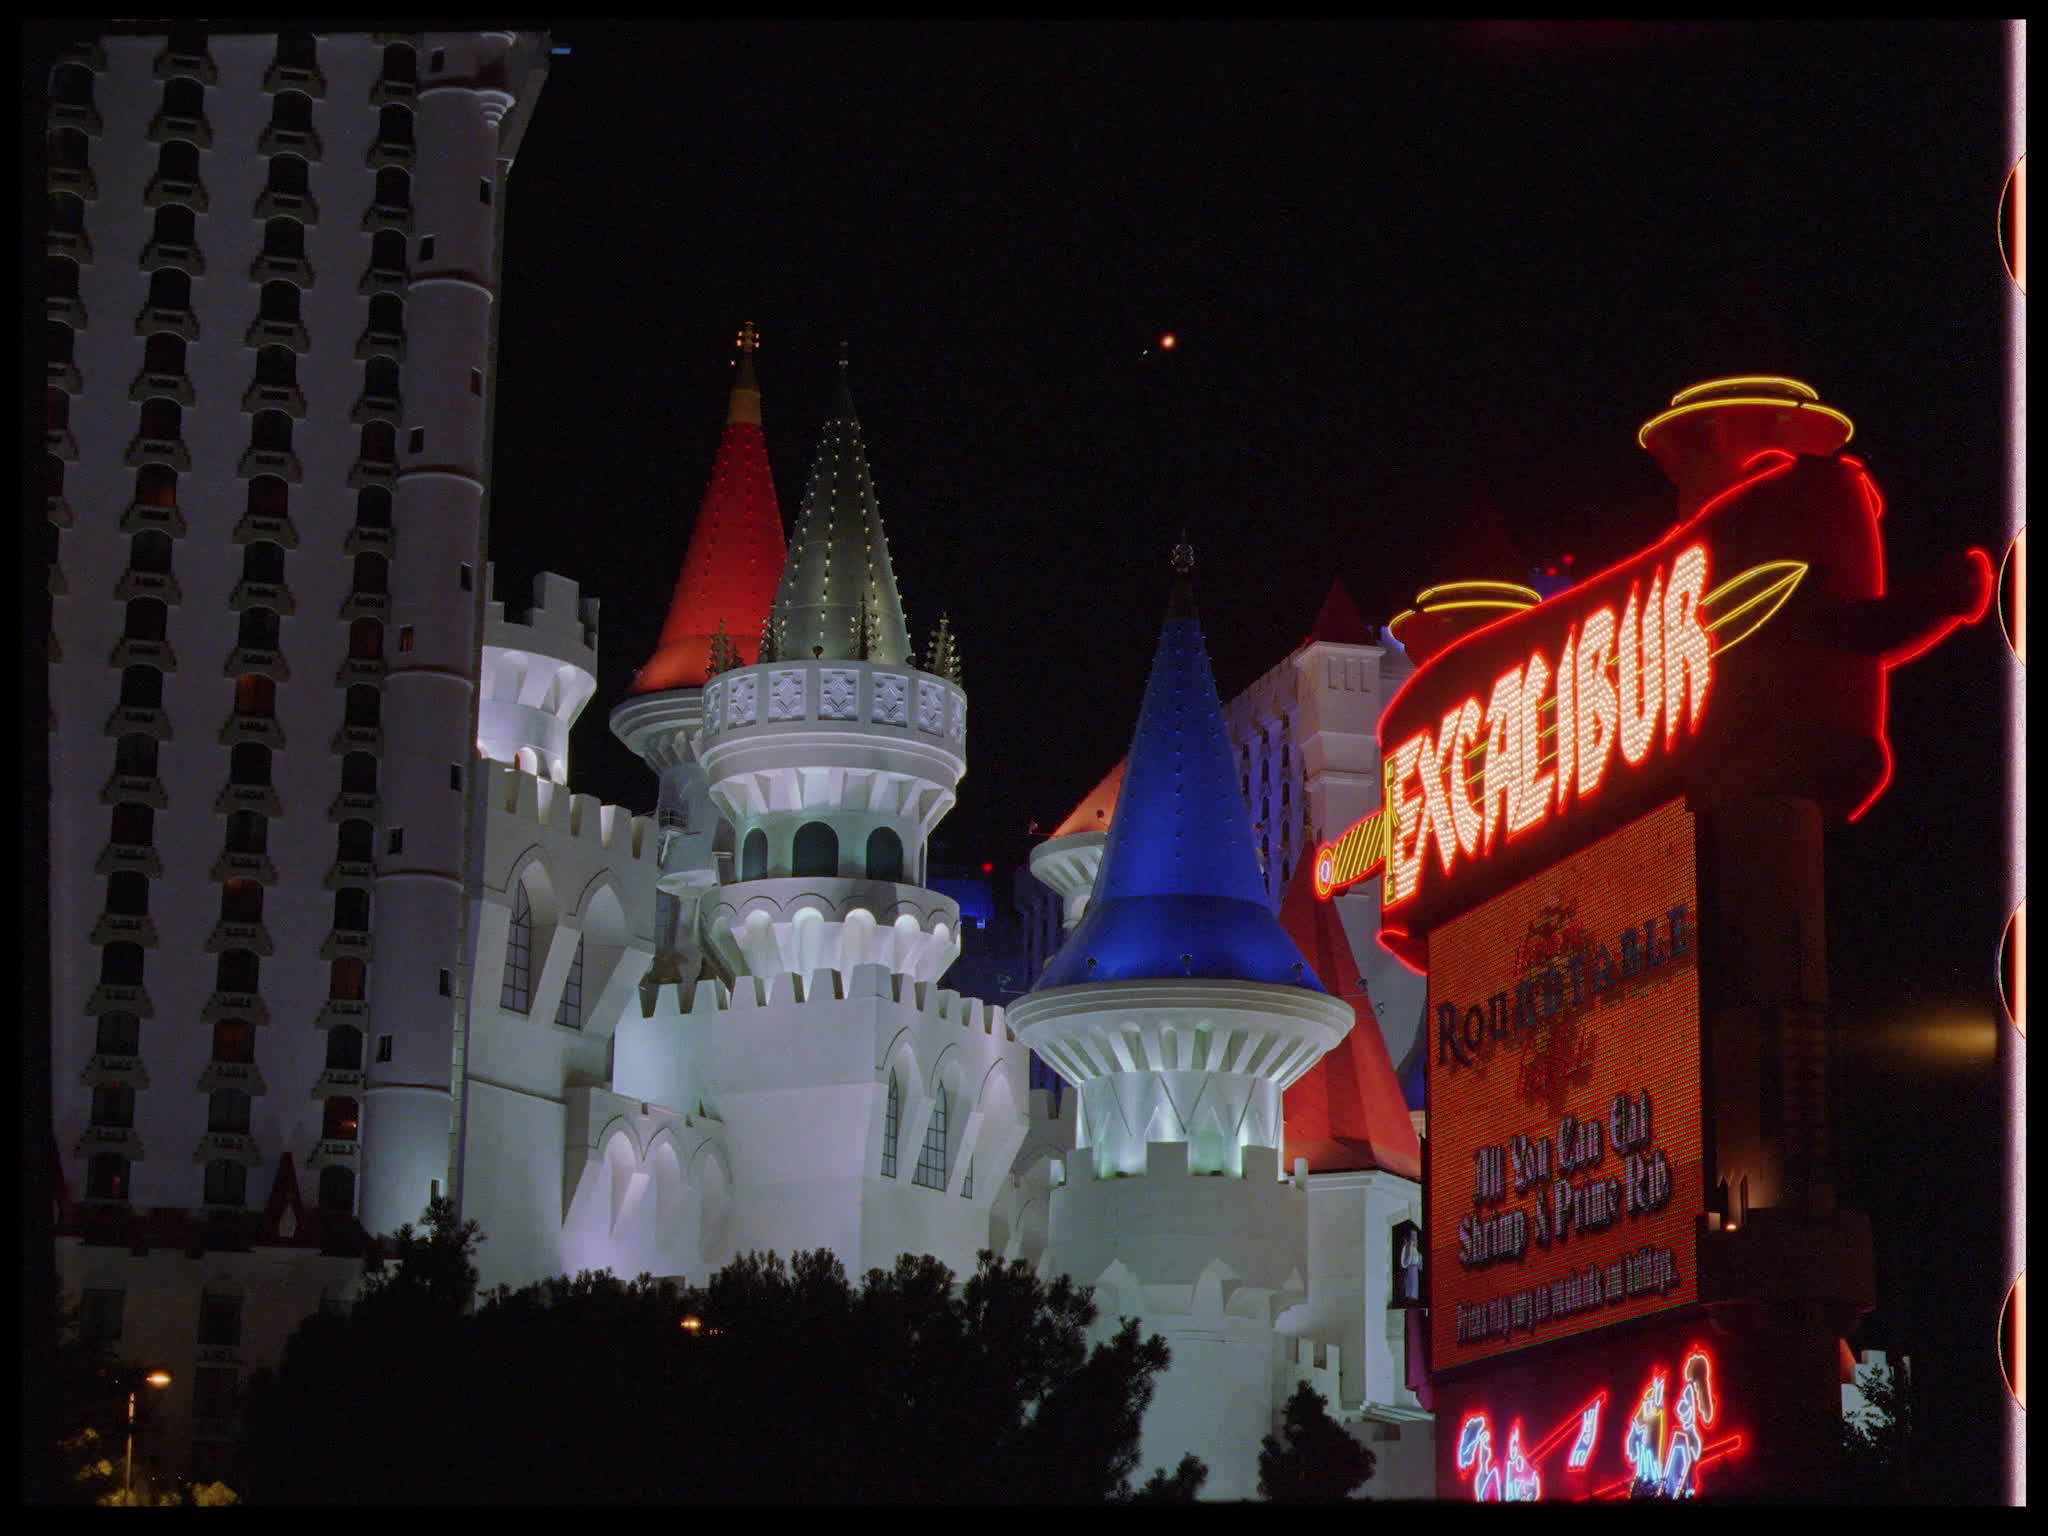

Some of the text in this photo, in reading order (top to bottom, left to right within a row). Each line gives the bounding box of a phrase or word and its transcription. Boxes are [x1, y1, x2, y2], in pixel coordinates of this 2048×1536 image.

[1389, 544, 1712, 902] EXCALIBUR
[1475, 1091, 1647, 1199] All You Can Eat
[1458, 1210, 1526, 1264] Shrimp
[1554, 1178, 1620, 1239] Prime
[1625, 1150, 1670, 1212] Rib
